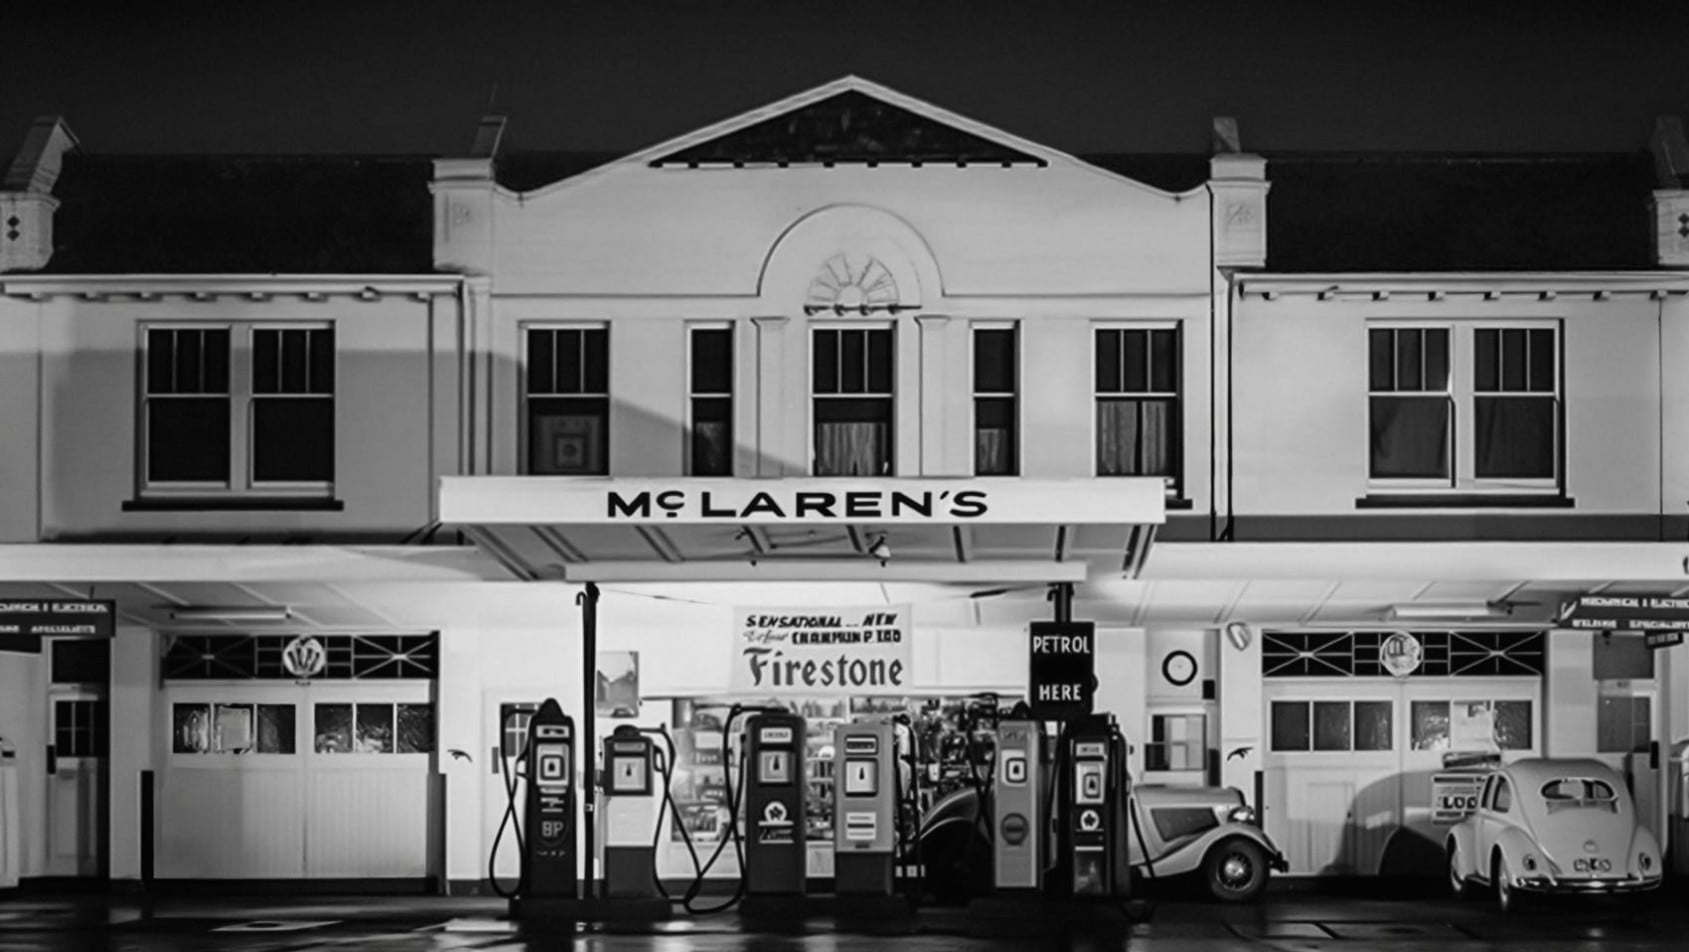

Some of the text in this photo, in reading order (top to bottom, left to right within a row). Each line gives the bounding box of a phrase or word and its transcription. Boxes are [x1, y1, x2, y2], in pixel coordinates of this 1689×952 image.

[745, 612, 898, 628] SENSATIONAL NEW
[1033, 635, 1091, 654] PETROL
[742, 646, 903, 687] Firestone
[1039, 683, 1082, 701] HERE
[541, 820, 564, 838] BP
